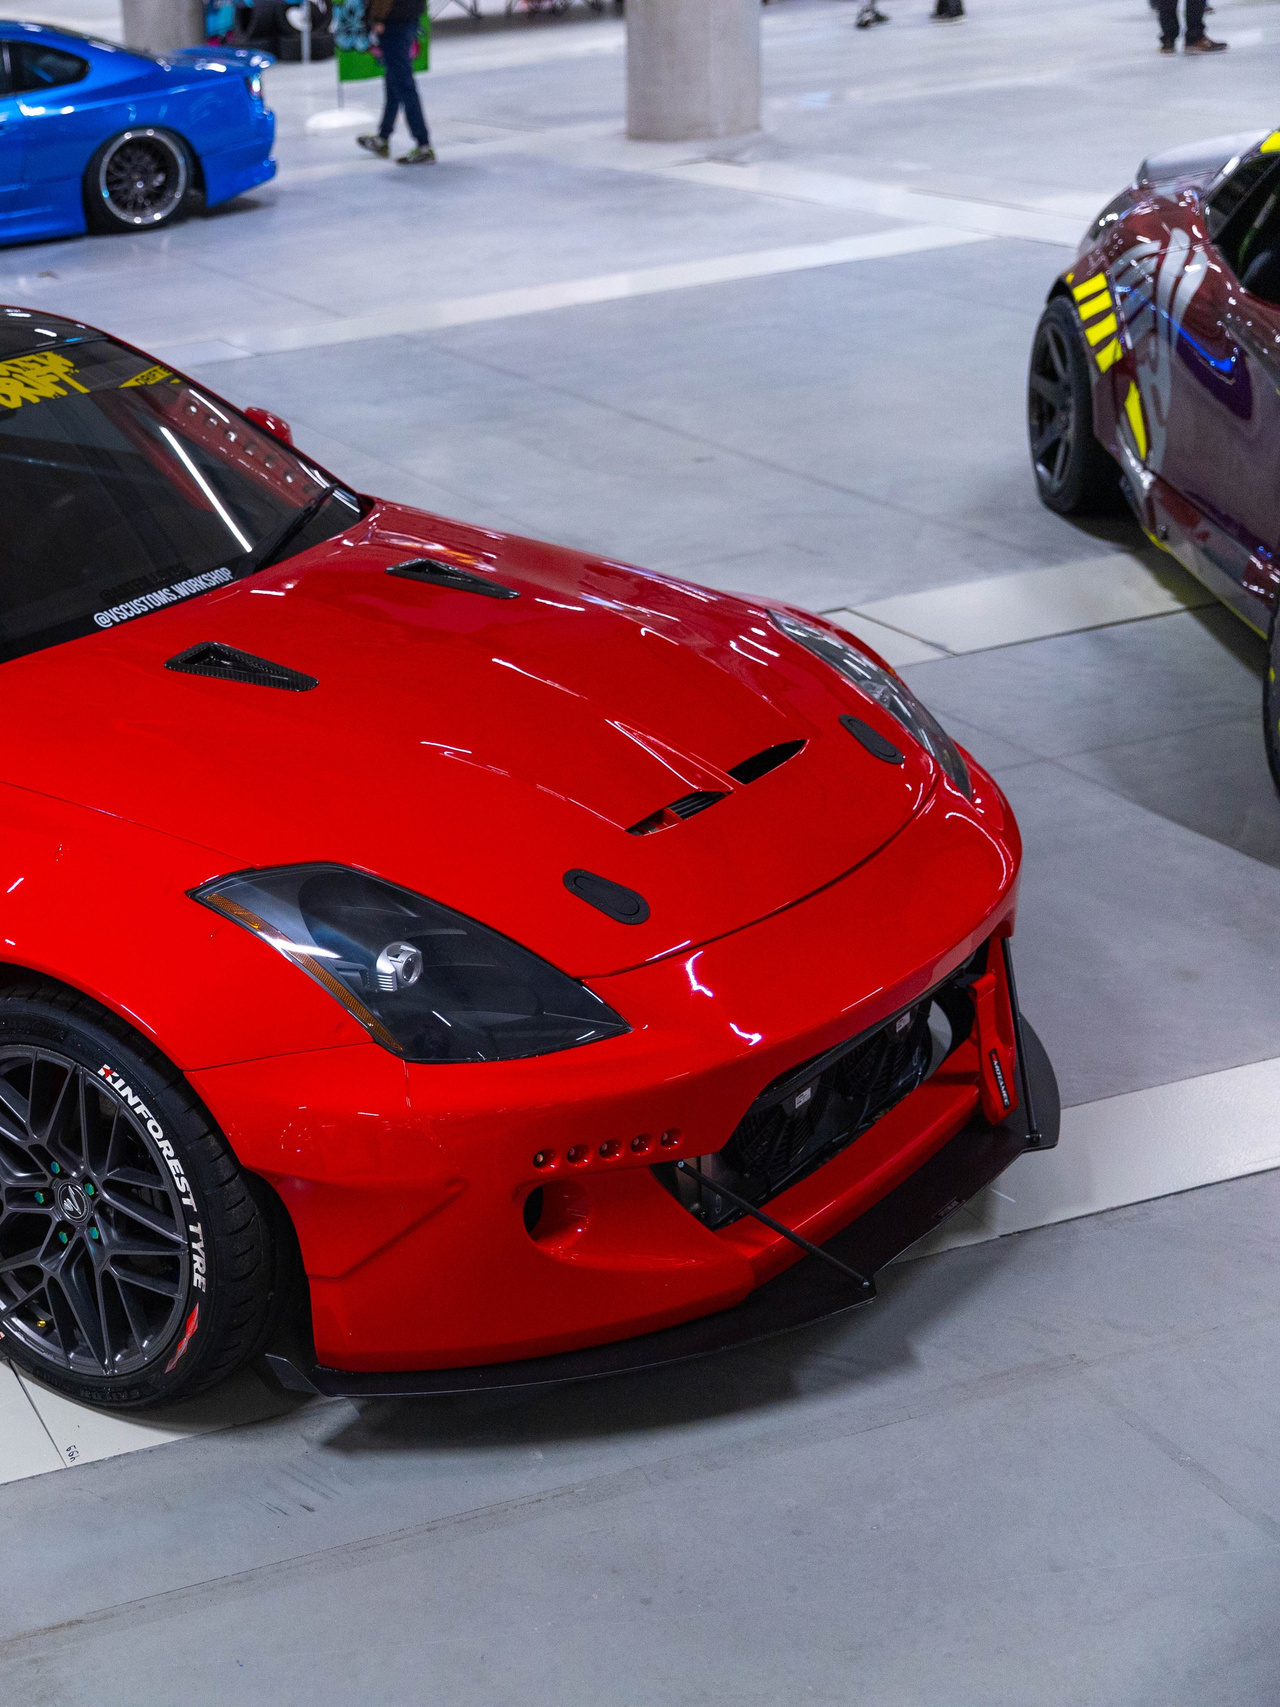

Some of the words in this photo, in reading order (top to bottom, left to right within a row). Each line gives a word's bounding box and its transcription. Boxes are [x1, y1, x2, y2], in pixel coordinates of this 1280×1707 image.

[93, 567, 234, 628] @VSCUSTOMS.WORKSHOP
[97, 1064, 198, 1213] KINFOREST
[185, 1222, 208, 1292] TYRE
